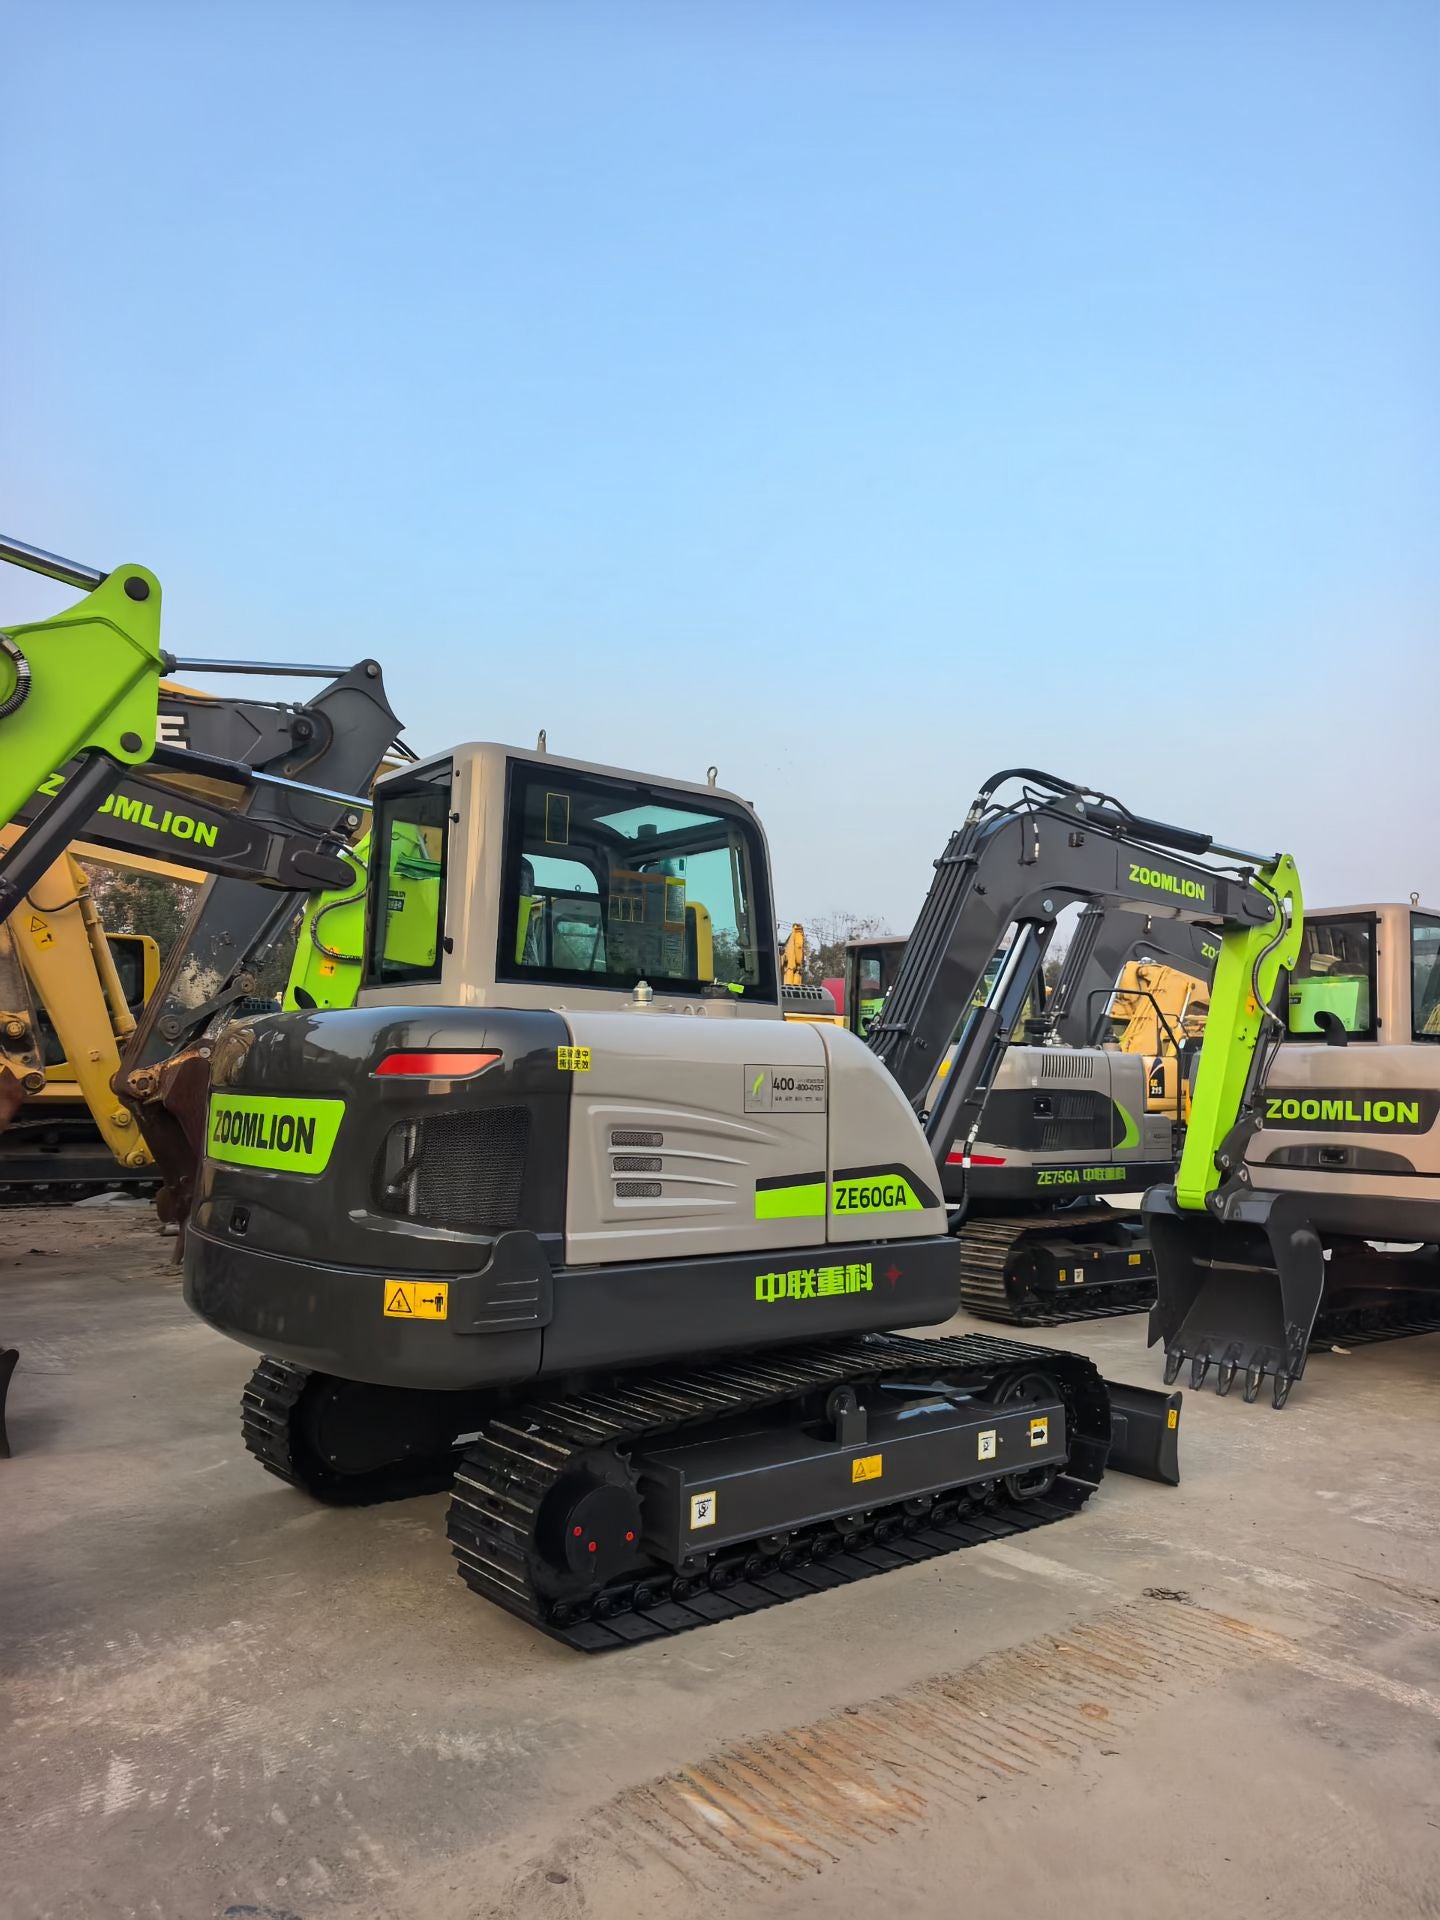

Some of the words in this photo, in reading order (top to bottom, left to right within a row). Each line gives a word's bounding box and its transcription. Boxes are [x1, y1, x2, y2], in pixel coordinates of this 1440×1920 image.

[37, 773, 218, 848] ZMLION
[1129, 864, 1205, 901] ZOOMLION
[1201, 942, 1220, 960] ZO
[1266, 1099, 1419, 1124] ZOOMLION
[213, 1110, 316, 1155] ZOOMLION
[1037, 1170, 1080, 1185] ZE75GA
[835, 1185, 907, 1210] ZE60GA
[755, 1263, 874, 1303] 中联重科
